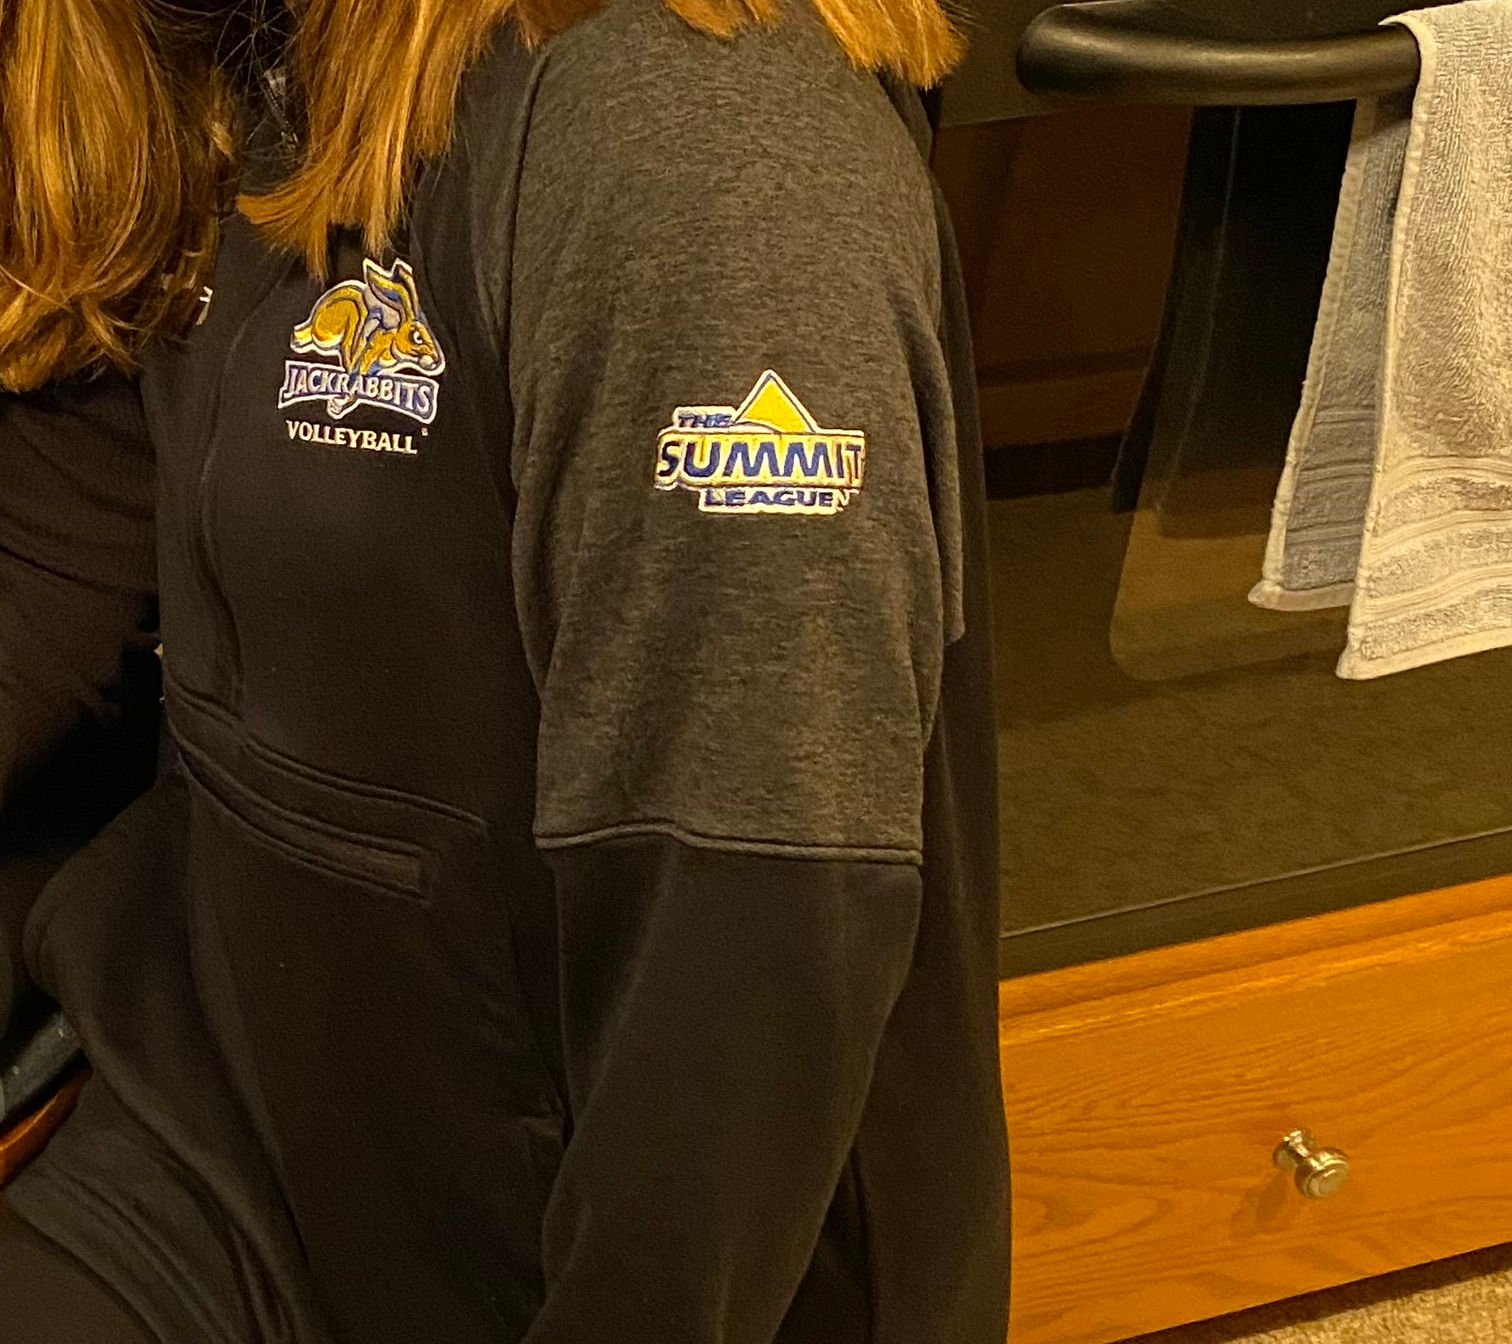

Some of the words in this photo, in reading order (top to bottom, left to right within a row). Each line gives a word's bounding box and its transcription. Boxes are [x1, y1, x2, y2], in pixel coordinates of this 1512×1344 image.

[283, 367, 433, 413] JACKRABBITS
[286, 419, 418, 455] VOLLEYBALL
[678, 412, 733, 428] THE
[658, 441, 863, 480] SUMMIT
[704, 489, 834, 507] LEAGUE
